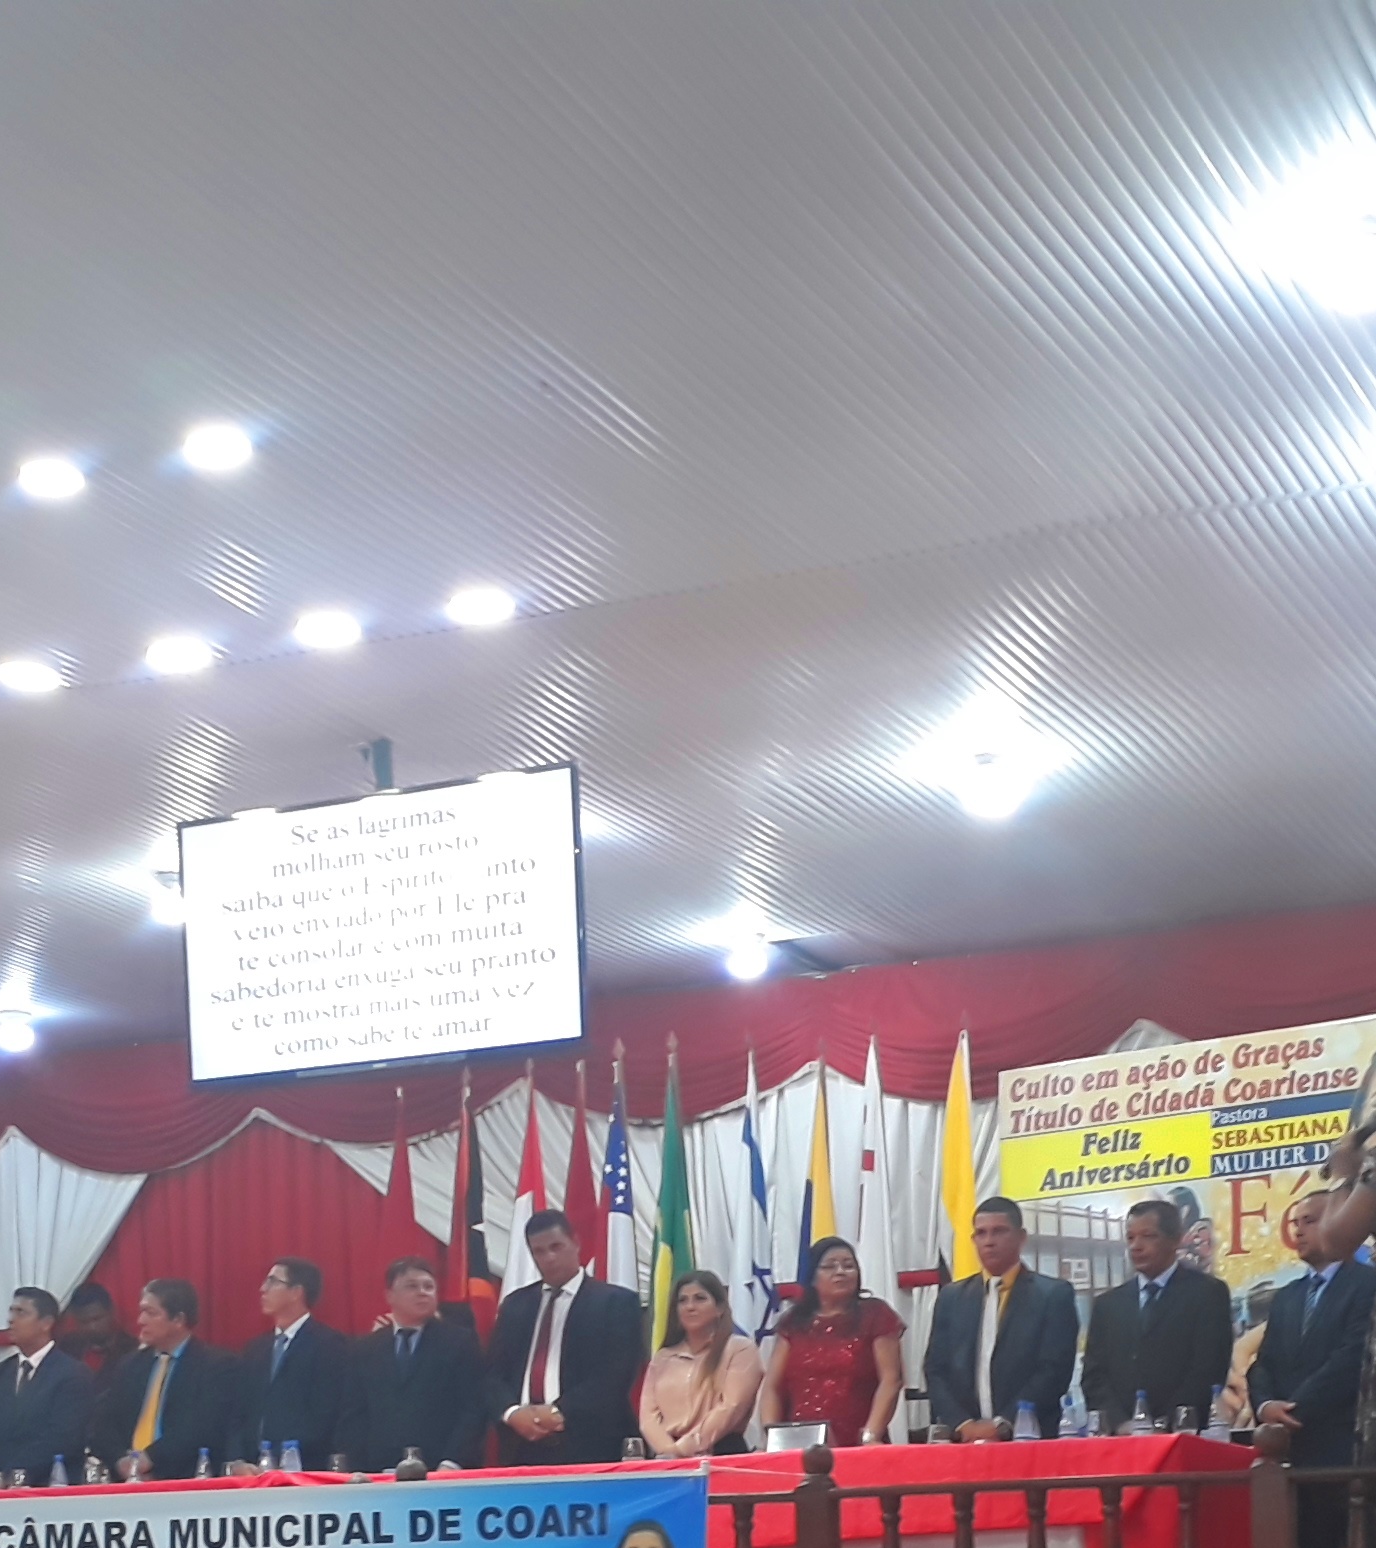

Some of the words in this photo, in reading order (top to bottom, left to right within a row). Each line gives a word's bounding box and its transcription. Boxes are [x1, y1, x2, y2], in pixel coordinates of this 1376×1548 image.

[290, 824, 319, 846] Se
[327, 824, 350, 840] as
[272, 852, 365, 878] molham
[418, 836, 479, 857] rosto
[221, 890, 283, 915] saiba
[292, 887, 333, 909] que
[486, 890, 526, 914] pra
[238, 955, 259, 971] te
[452, 921, 523, 943] muita
[210, 976, 326, 1005] sabedoria
[472, 947, 557, 977] pranto
[253, 1012, 274, 1028] te
[283, 1003, 360, 1025] mostra
[430, 988, 480, 1007] uma
[273, 1033, 339, 1057] como
[1009, 1072, 1074, 1103] Culto
[1082, 1068, 1119, 1092] em
[1126, 1054, 1187, 1090] ação
[1193, 1048, 1226, 1077] de
[1232, 1037, 1325, 1070] Graças
[1010, 1103, 1084, 1135] Título
[1089, 1097, 1119, 1123] de
[1126, 1080, 1215, 1118] Cidadã
[1224, 1066, 1358, 1103] Coariense
[1212, 1107, 1268, 1126] Pastora
[1080, 1128, 1142, 1157] Feliz
[1212, 1115, 1343, 1150] SEBASTIANA
[1039, 1152, 1191, 1192] Aniversário
[1212, 1145, 1309, 1175] MULHER
[408, 1506, 462, 1544] DE
[475, 1502, 609, 1541] COARI
